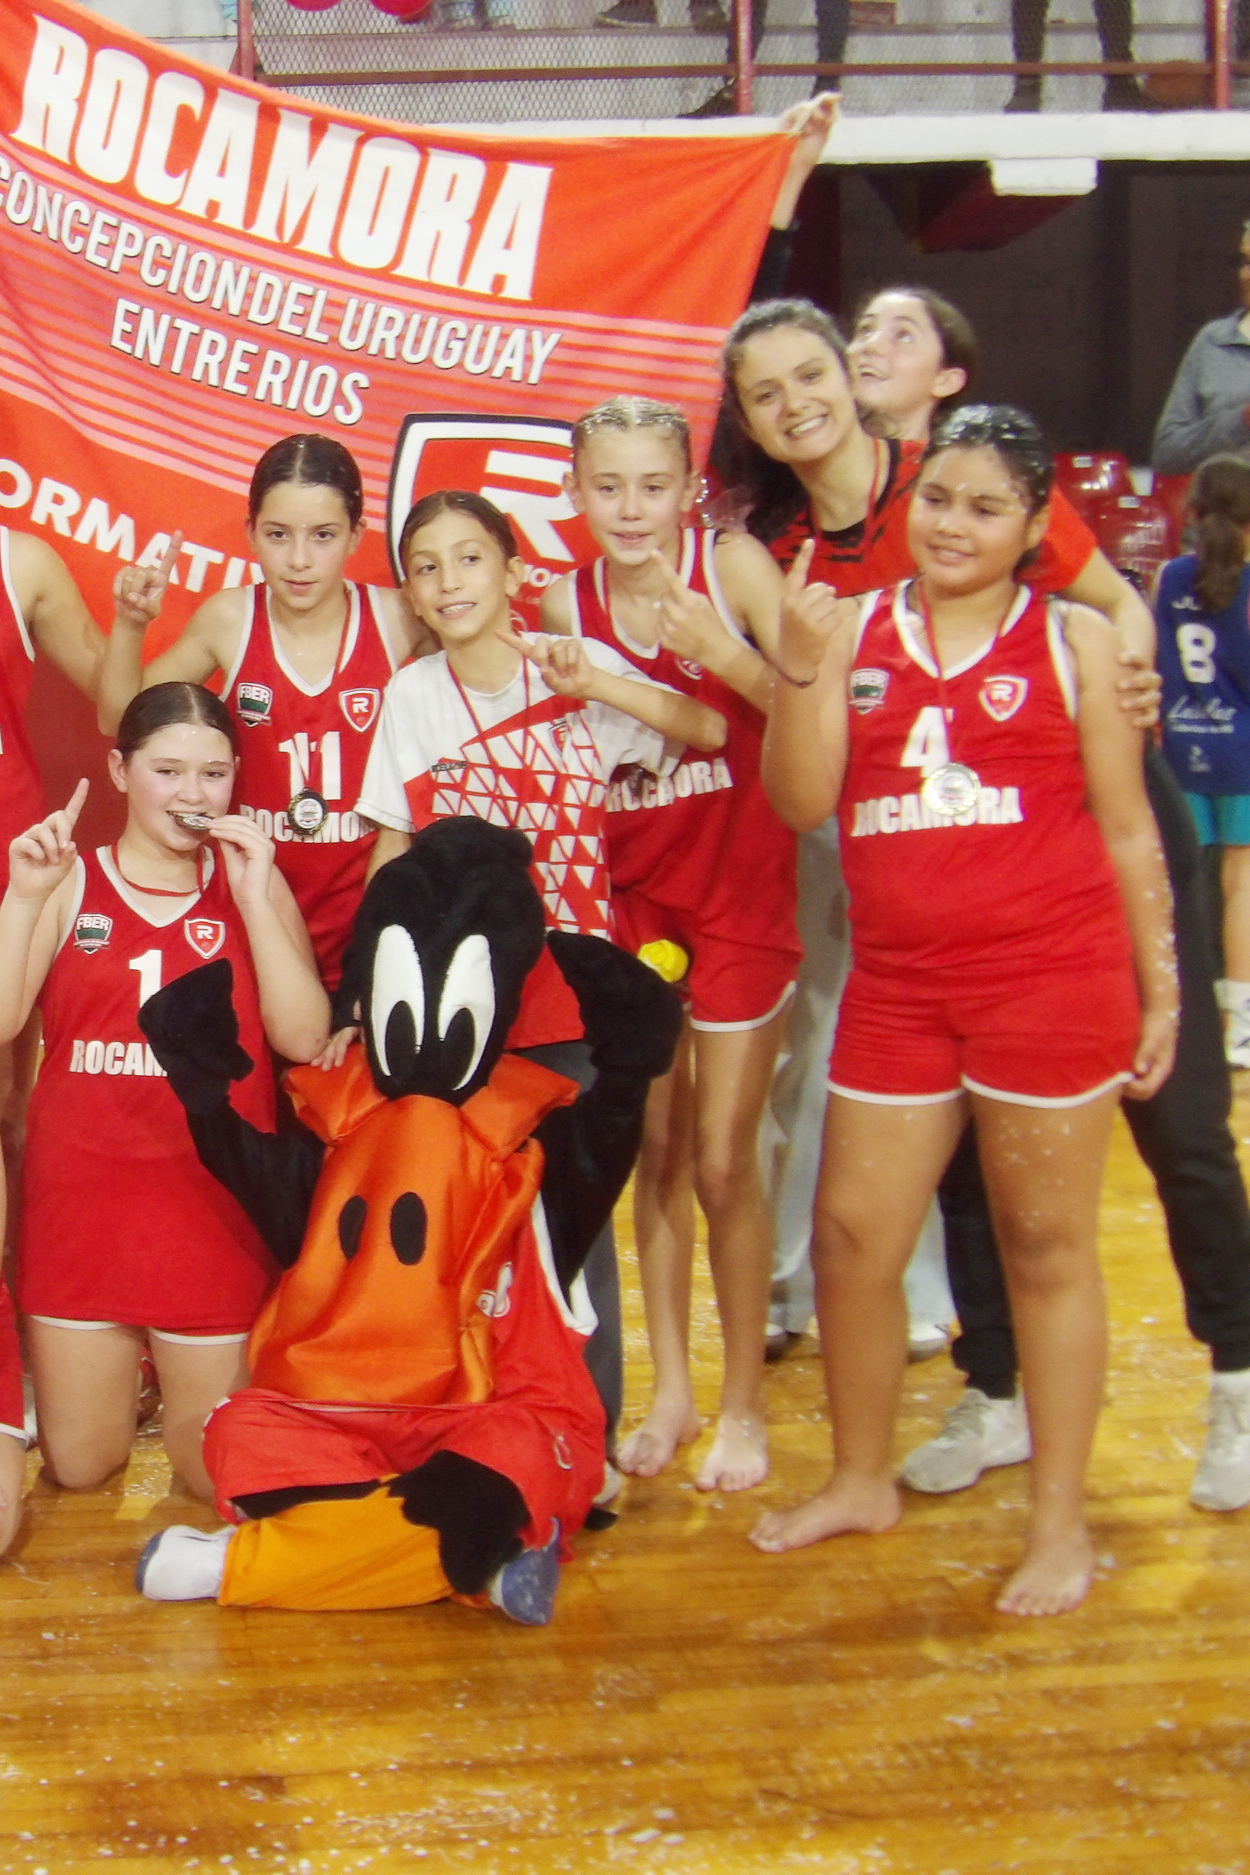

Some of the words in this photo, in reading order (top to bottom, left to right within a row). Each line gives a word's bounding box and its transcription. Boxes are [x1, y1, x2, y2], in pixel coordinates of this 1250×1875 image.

[9, 14, 553, 300] ROCAMORA
[247, 271, 329, 344] DEL
[340, 288, 562, 385] URUGUAY
[110, 298, 259, 395] ENTRE
[256, 352, 370, 425] RIOS
[1175, 623, 1217, 683] 8
[239, 687, 270, 704] FBER
[352, 698, 369, 713] R
[279, 731, 342, 800] 11
[900, 706, 954, 778] 4
[76, 915, 109, 931] FBER
[197, 925, 213, 940] R
[129, 950, 162, 1008] 1
